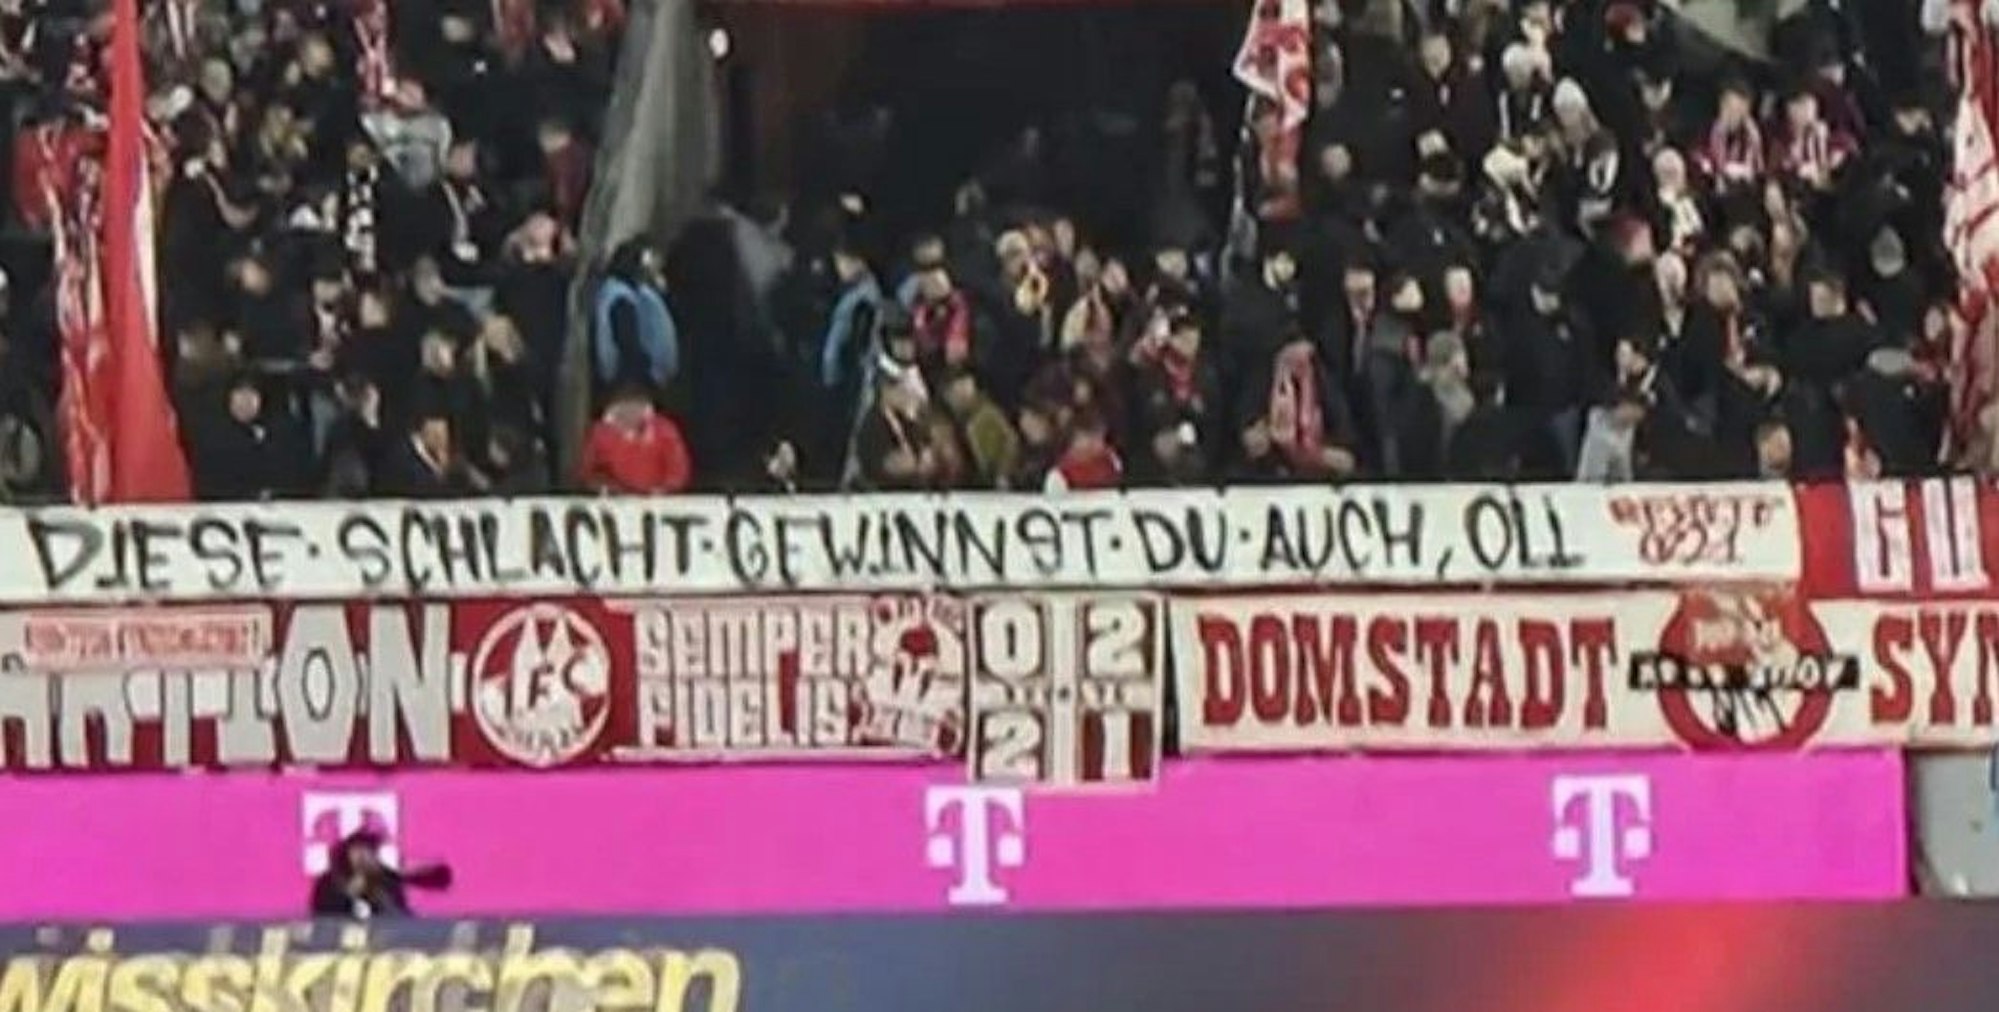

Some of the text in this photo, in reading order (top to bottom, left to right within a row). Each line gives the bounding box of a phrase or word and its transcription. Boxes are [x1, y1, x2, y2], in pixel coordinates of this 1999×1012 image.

[27, 507, 301, 590] DIESE
[337, 505, 708, 592] SCHLACHT
[1132, 505, 1228, 573] DU
[634, 604, 870, 680] SEMPER
[1197, 613, 1617, 729] DOMSTADT
